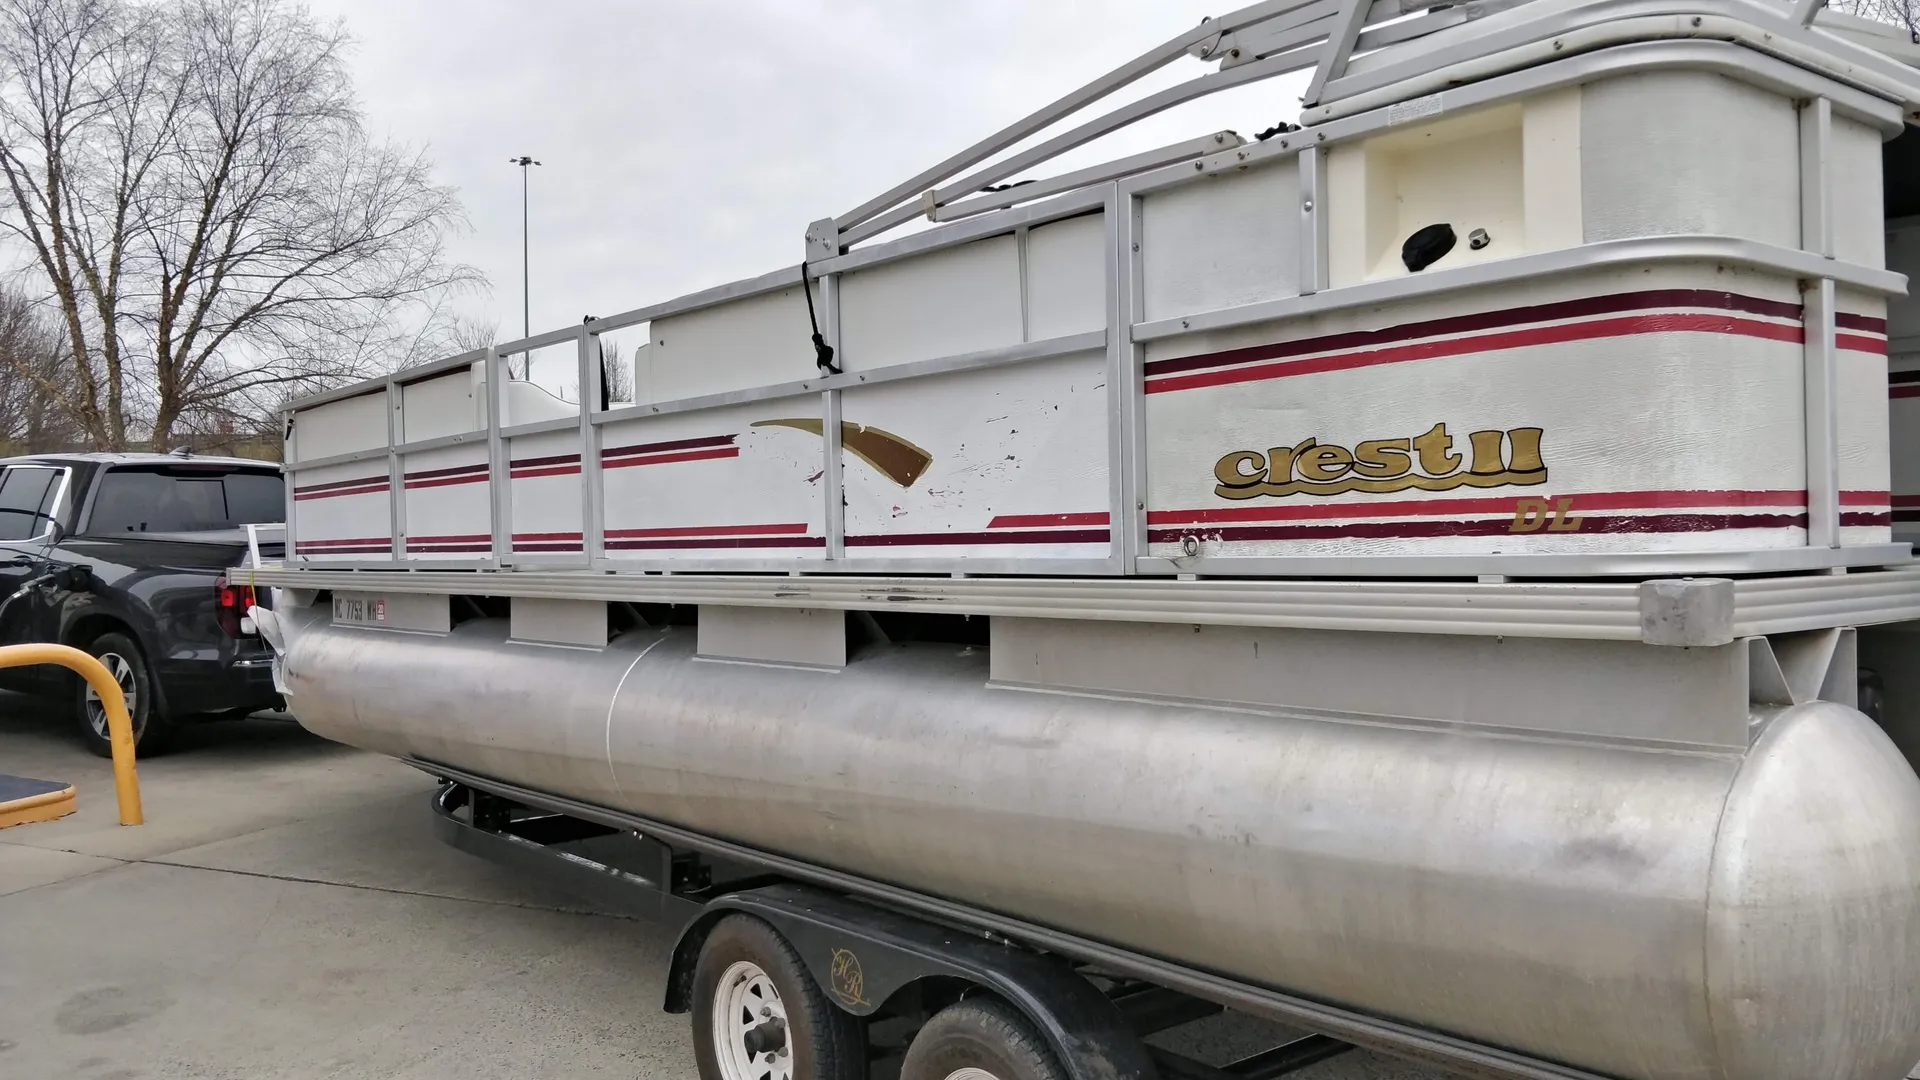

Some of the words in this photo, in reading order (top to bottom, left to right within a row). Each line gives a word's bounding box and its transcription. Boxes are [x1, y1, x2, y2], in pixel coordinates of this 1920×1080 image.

[1214, 422, 1463, 487] crest
[1508, 497, 1584, 532] DL
[334, 598, 343, 619] NC
[346, 600, 363, 620] 7753
